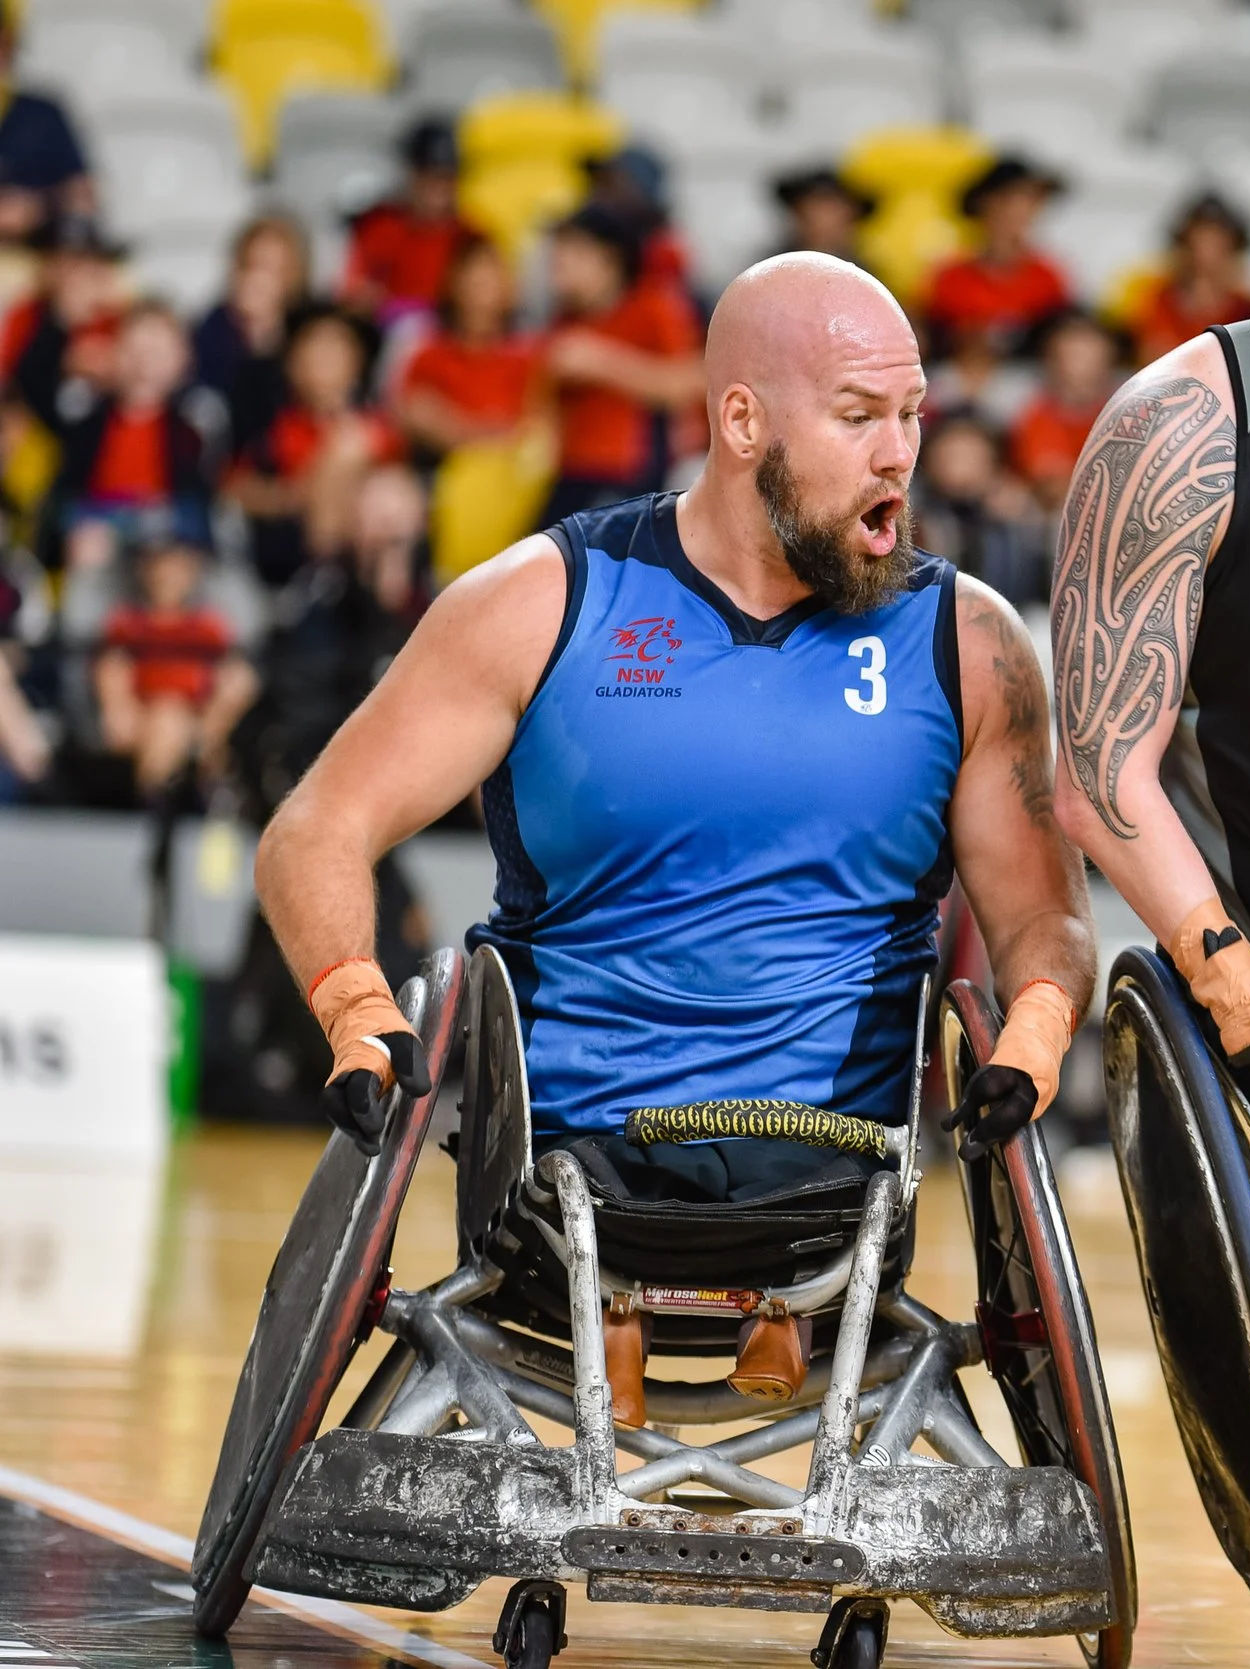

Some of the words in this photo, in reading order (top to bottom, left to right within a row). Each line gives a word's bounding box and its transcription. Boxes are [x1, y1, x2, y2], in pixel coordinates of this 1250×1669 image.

[616, 668, 665, 684] NSW
[843, 635, 888, 716] 3
[595, 686, 683, 699] GLADIATORS
